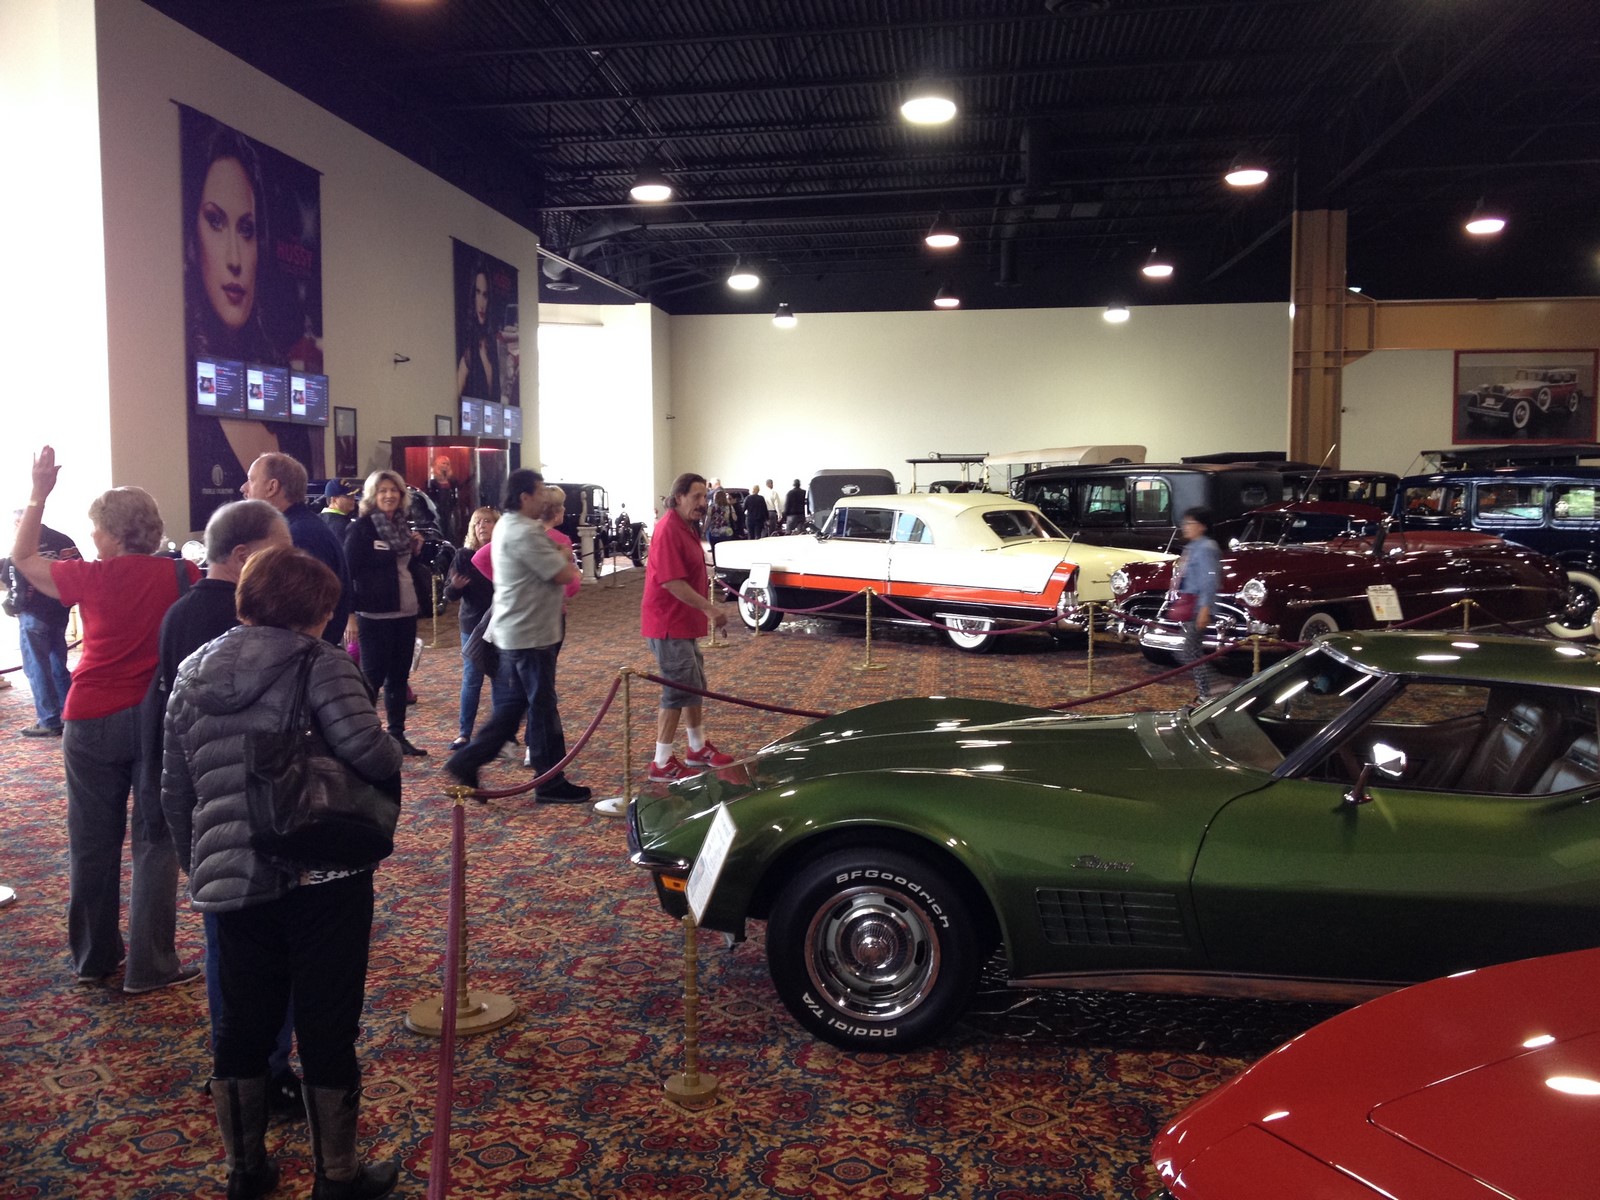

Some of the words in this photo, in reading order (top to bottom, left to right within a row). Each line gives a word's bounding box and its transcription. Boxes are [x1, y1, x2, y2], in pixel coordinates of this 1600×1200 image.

[836, 869, 950, 928] BFGoodrich
[802, 992, 825, 1018] T/A
[827, 1018, 898, 1038] Radial
